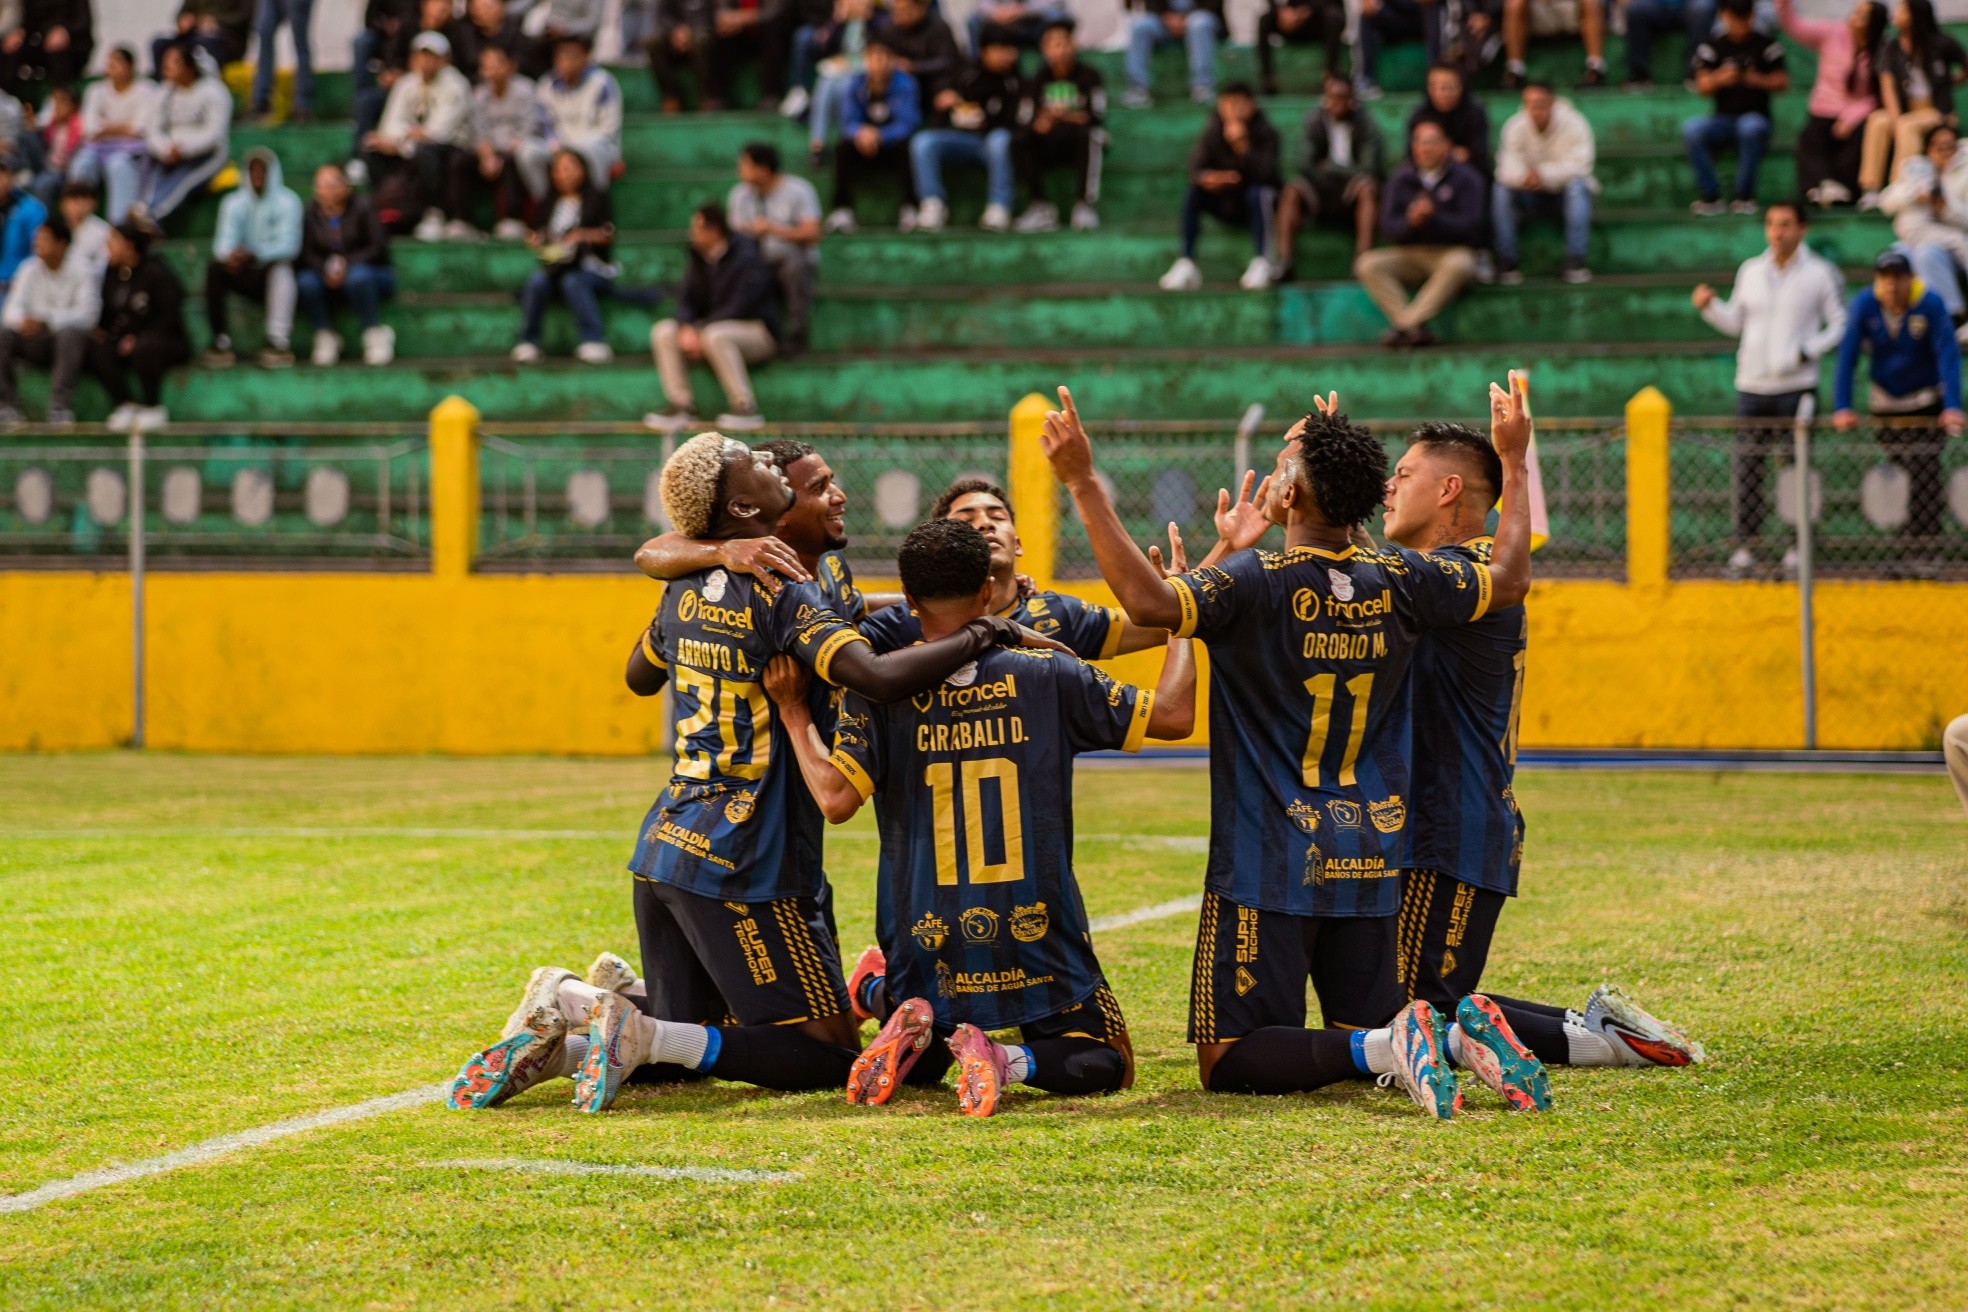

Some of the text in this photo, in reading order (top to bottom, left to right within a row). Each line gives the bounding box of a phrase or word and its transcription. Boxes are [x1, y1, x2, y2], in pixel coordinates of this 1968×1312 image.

[677, 637, 756, 674] ARROYO A.
[1303, 632, 1368, 659] OROBIO
[937, 673, 1017, 707] francell
[674, 664, 771, 780] 20
[1010, 716, 1030, 743] D.
[1302, 672, 1375, 788] 11
[661, 821, 711, 851] ALCALDÍA
[924, 757, 1025, 886] 10
[707, 853, 735, 870] SANTA
[1325, 856, 1385, 870] ALCALDÍA
[1352, 871, 1362, 879] DE
[1363, 870, 1382, 878] AGUA
[742, 917, 777, 984] SUPER
[1236, 904, 1249, 963] SUPE
[1249, 908, 1258, 963] TECPHO
[733, 921, 765, 986] TECPHONE
[956, 967, 1026, 985] ALCALDÍA
[986, 984, 999, 993] DE
[1001, 980, 1025, 991] AGUA
[1026, 975, 1054, 987] SANTA
